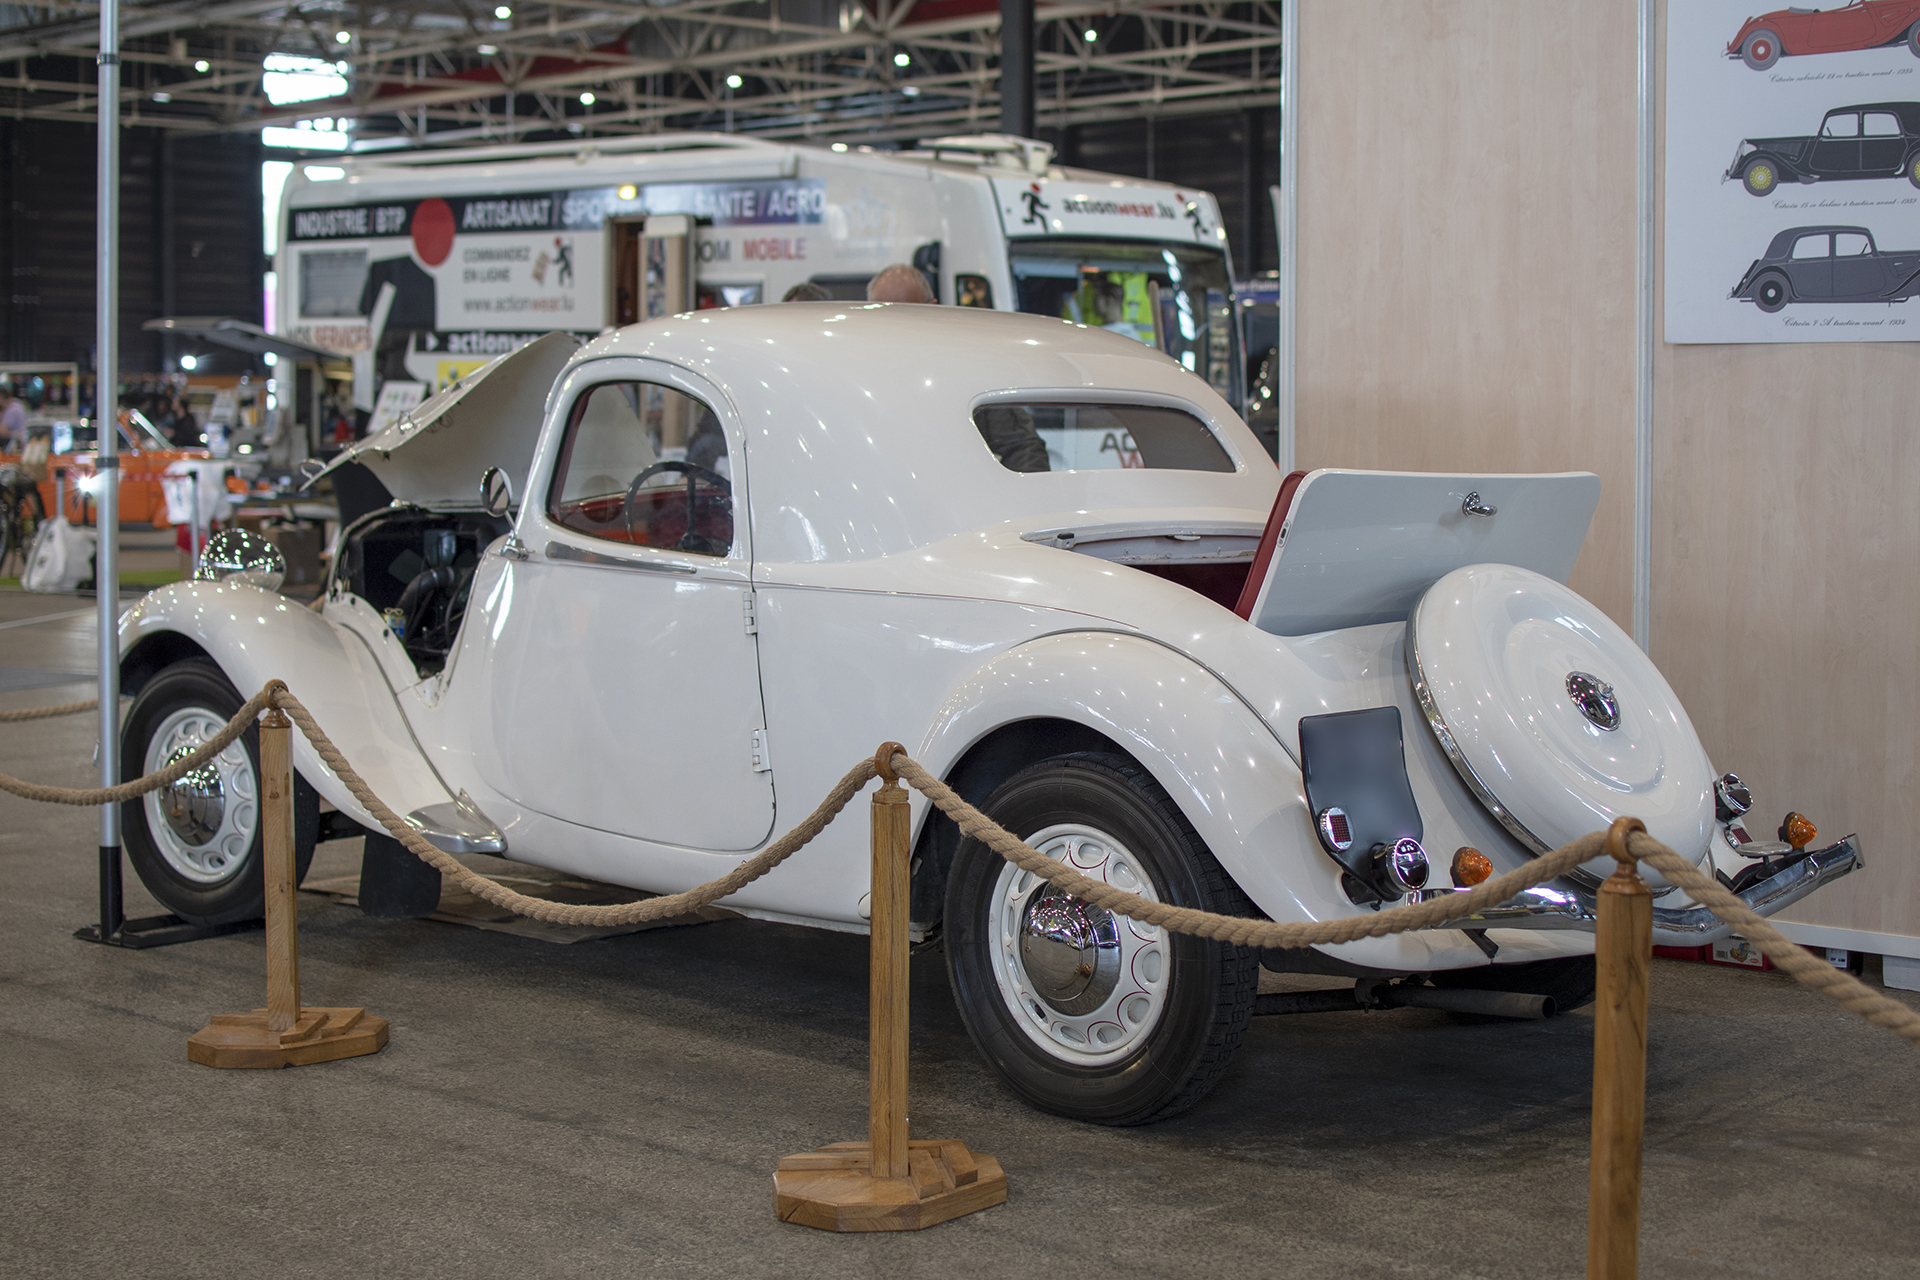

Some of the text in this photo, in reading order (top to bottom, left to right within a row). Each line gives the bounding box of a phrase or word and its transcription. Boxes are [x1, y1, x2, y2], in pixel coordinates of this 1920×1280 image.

[1844, 70, 1870, 78] traction
[1897, 67, 1914, 75] 1934
[1062, 198, 1177, 220] actionwear.lu
[1876, 198, 1897, 206] avant
[296, 208, 368, 238] INDUSTRIE
[375, 206, 407, 233] BTP
[462, 199, 551, 229] ARTISANAT
[767, 188, 827, 216] AGRO
[463, 245, 531, 263] COMMANDEZ
[743, 237, 808, 261] MOBILE
[463, 266, 510, 283] EN LIGNE
[463, 293, 575, 313] www.actionwear.lu
[1862, 318, 1884, 326] avant
[315, 326, 373, 351] SERVICES
